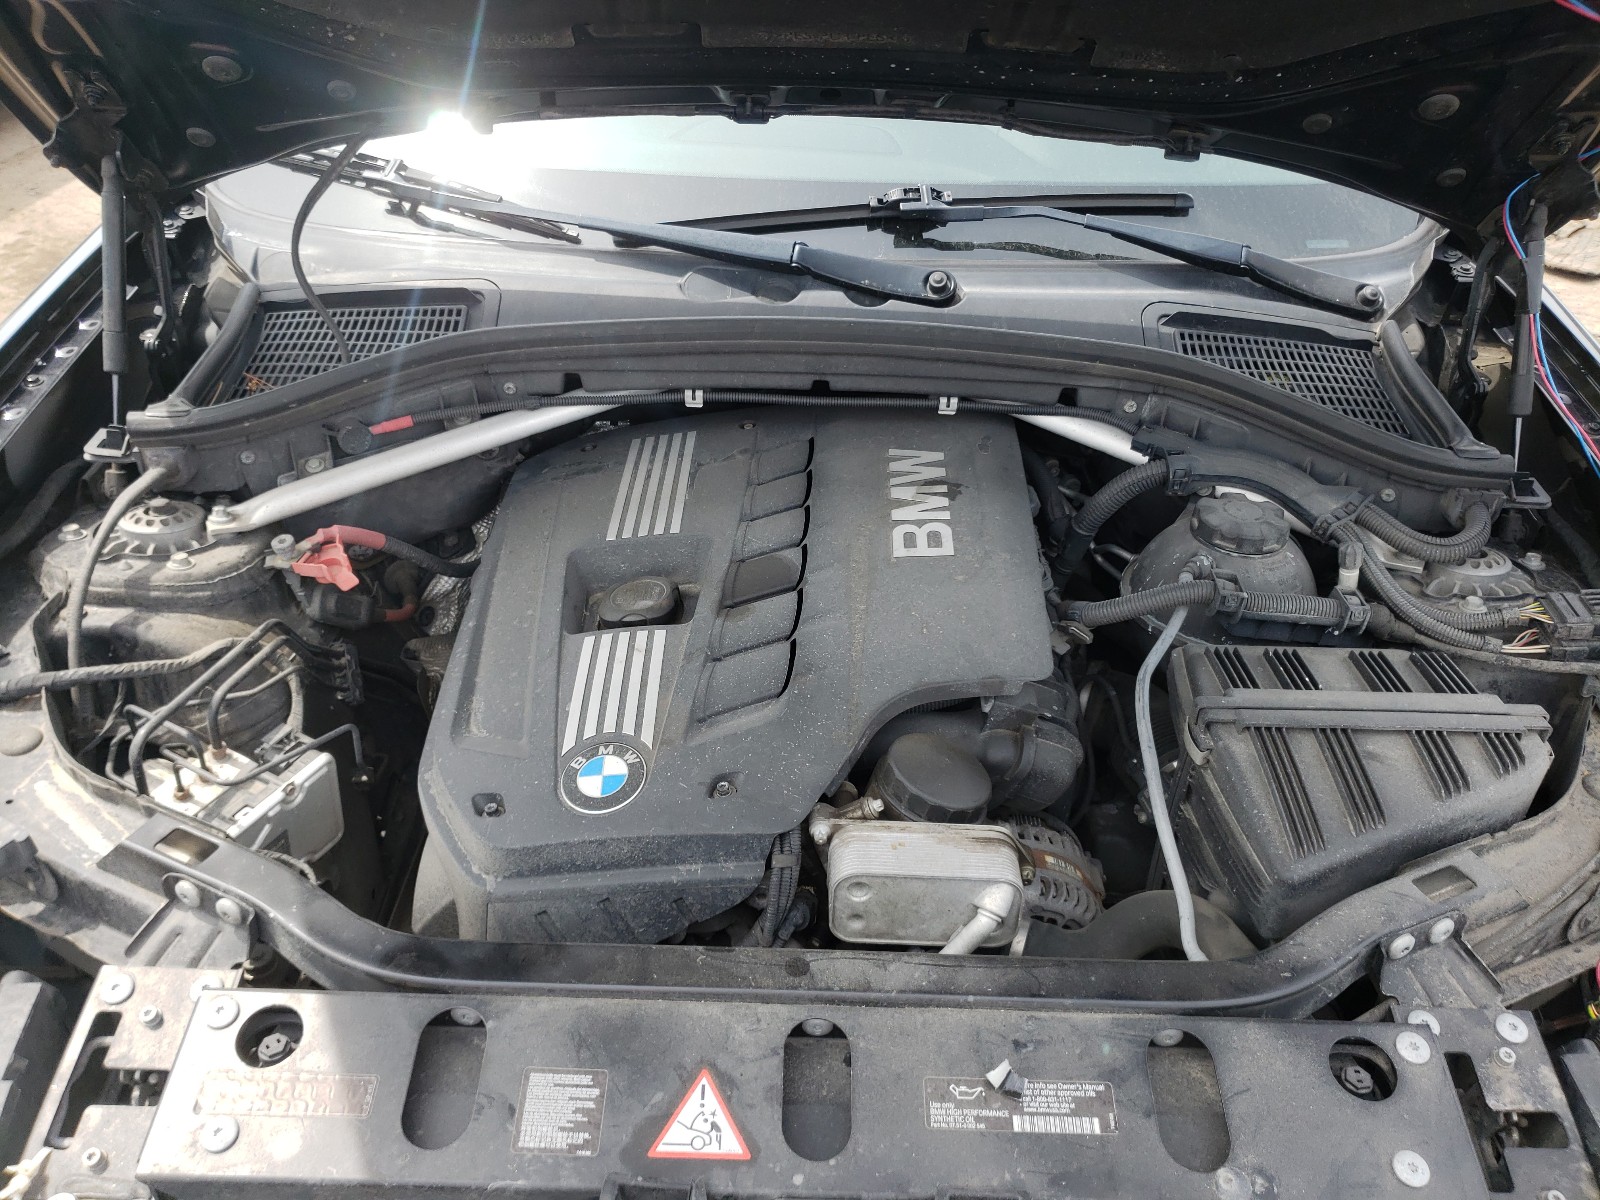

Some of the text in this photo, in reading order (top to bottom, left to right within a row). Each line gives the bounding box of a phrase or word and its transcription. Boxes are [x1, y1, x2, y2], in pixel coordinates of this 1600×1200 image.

[888, 448, 955, 558] BMW
[570, 745, 640, 769] BMW
[942, 1102, 954, 1110] only
[963, 1109, 1010, 1118] PERFORMANCE
